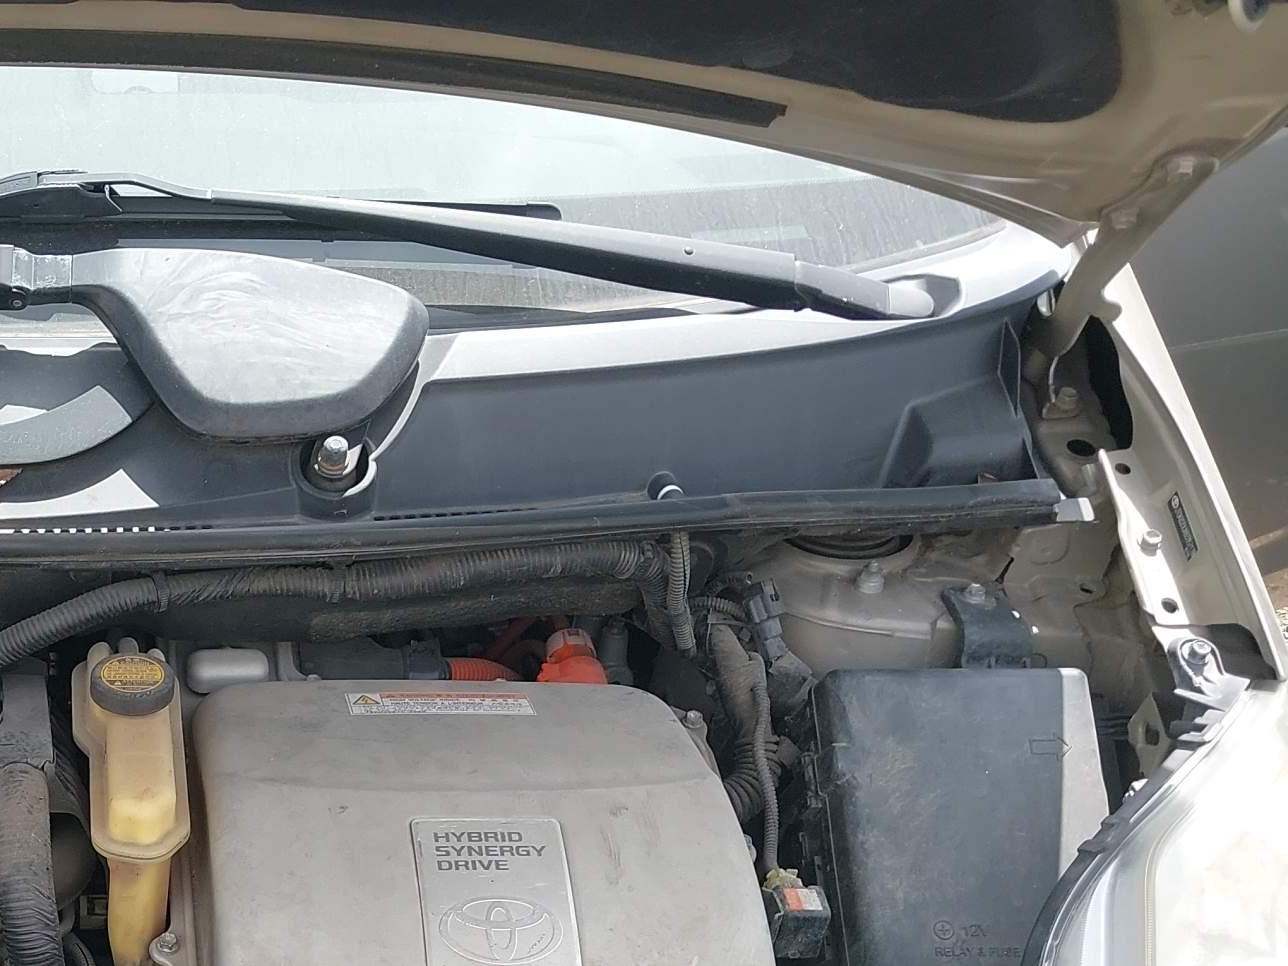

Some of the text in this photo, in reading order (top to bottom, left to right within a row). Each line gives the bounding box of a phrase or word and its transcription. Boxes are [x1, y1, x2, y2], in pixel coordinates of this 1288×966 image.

[433, 831, 523, 843] HYBRID
[435, 845, 546, 857] SYNERGY
[437, 859, 510, 871] DRIVE
